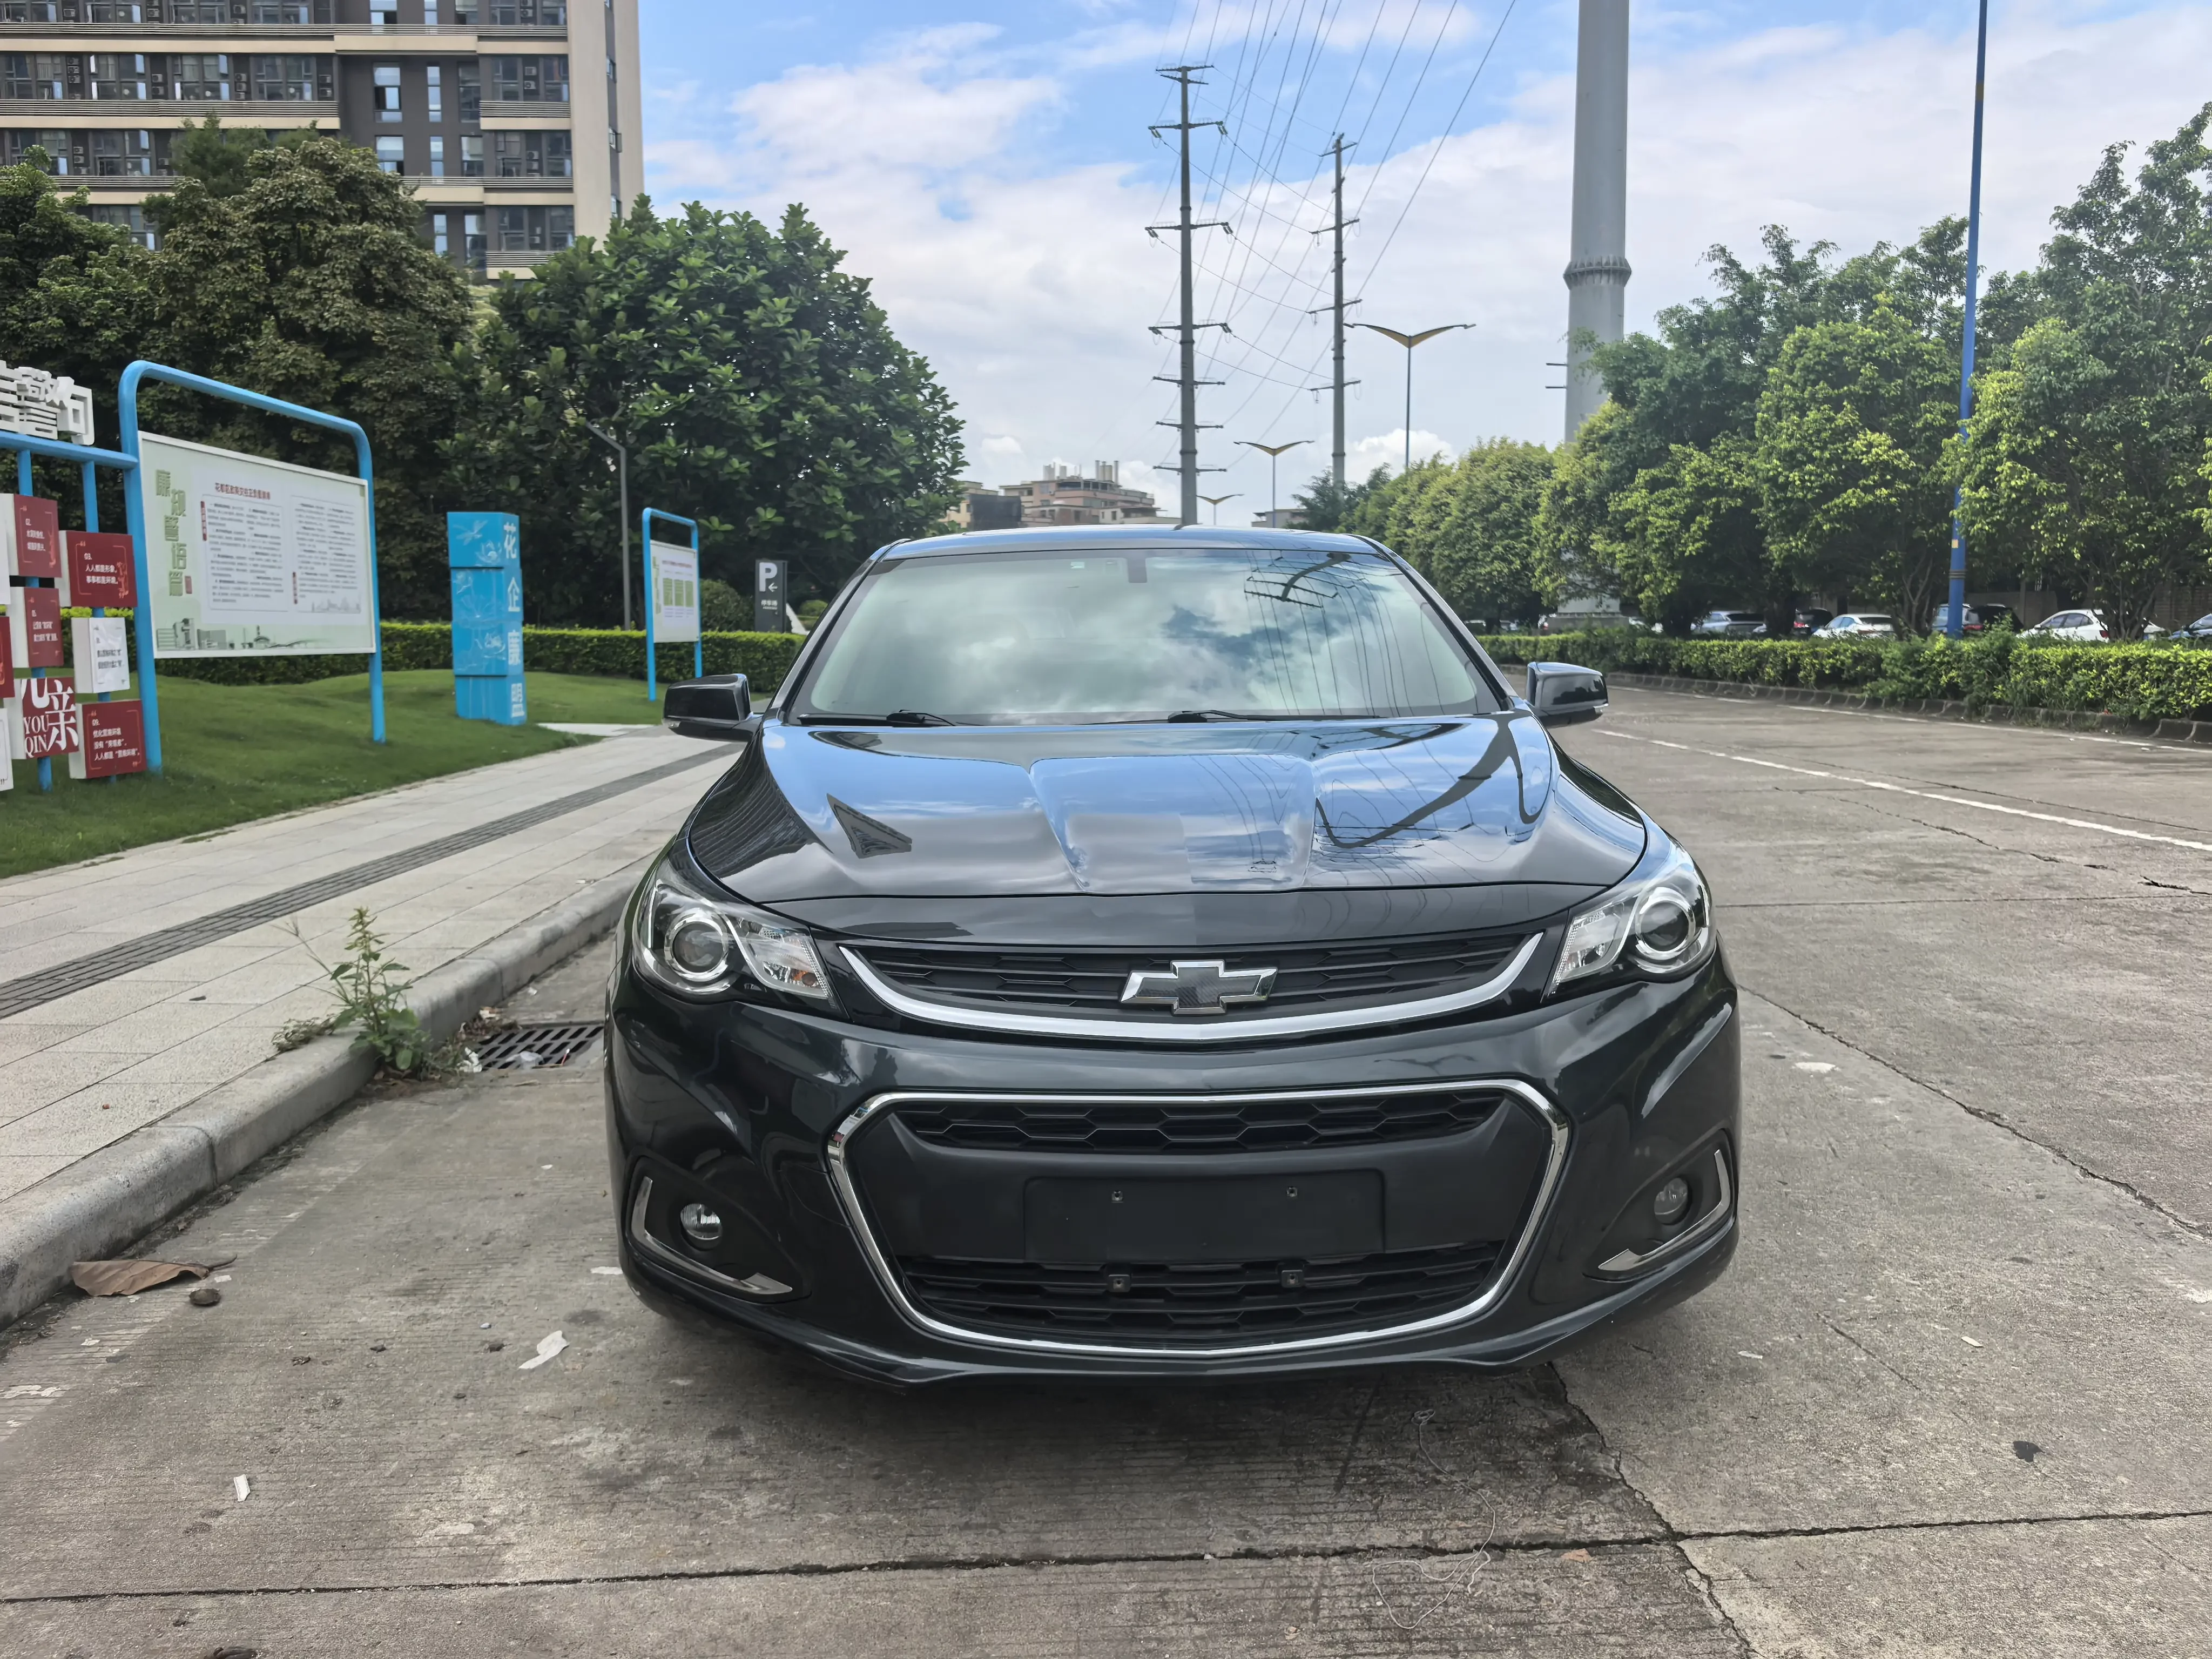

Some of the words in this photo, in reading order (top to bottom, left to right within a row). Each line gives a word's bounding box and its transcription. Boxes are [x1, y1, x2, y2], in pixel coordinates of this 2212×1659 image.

[759, 562, 778, 592] P
[24, 715, 49, 734] YOU
[24, 734, 48, 758] QIN
